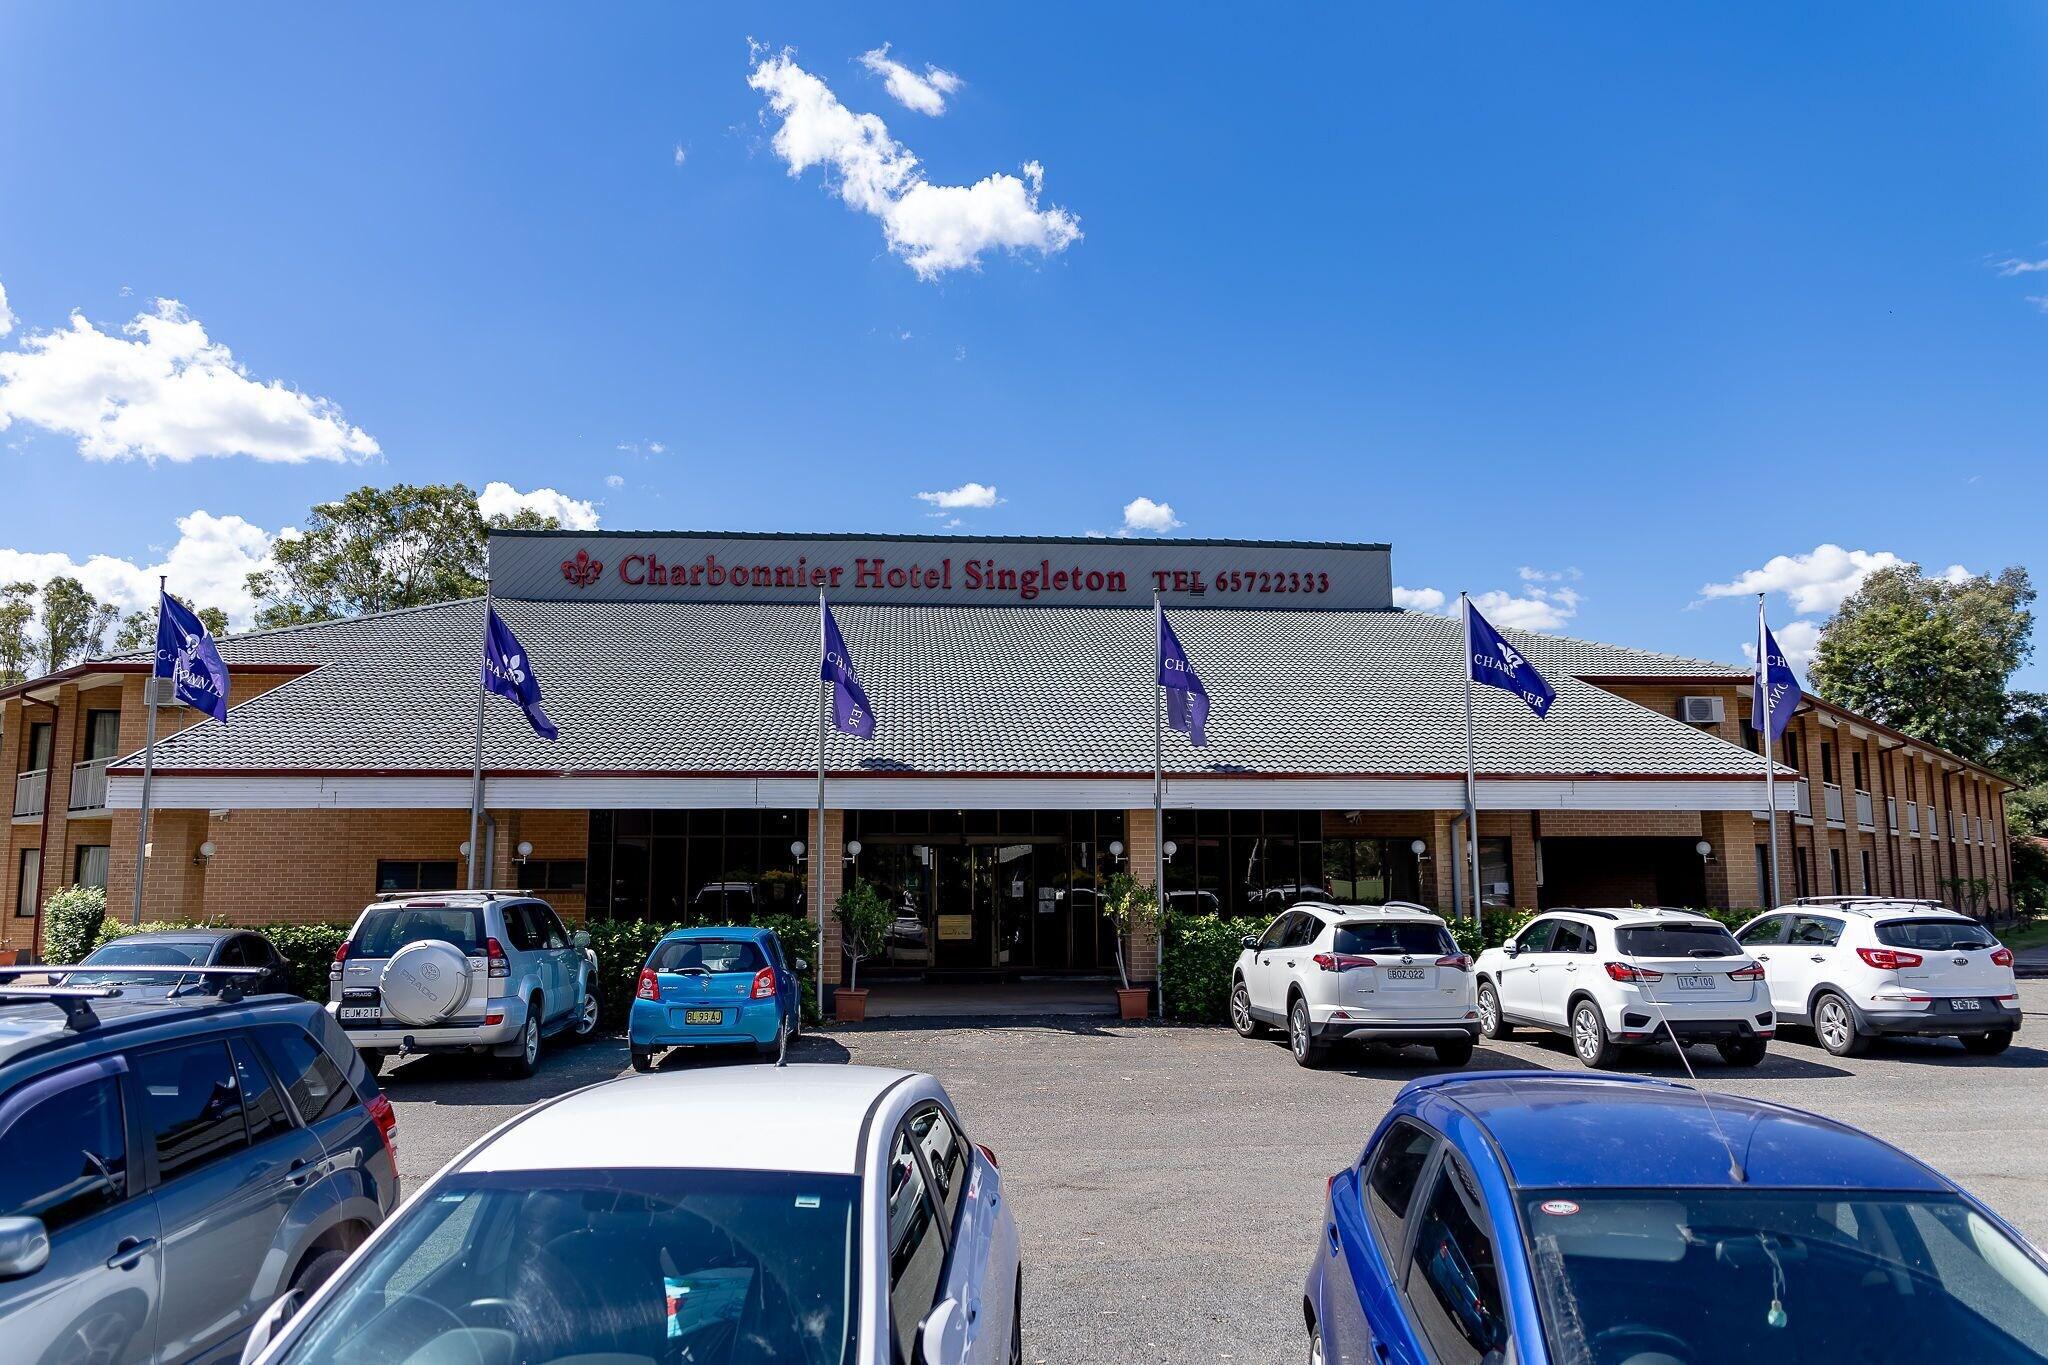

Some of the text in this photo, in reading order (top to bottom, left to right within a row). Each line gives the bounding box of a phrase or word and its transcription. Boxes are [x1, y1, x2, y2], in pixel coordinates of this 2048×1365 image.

[619, 554, 1330, 599] Charbonnier Hotel Singleton TEL 65722333
